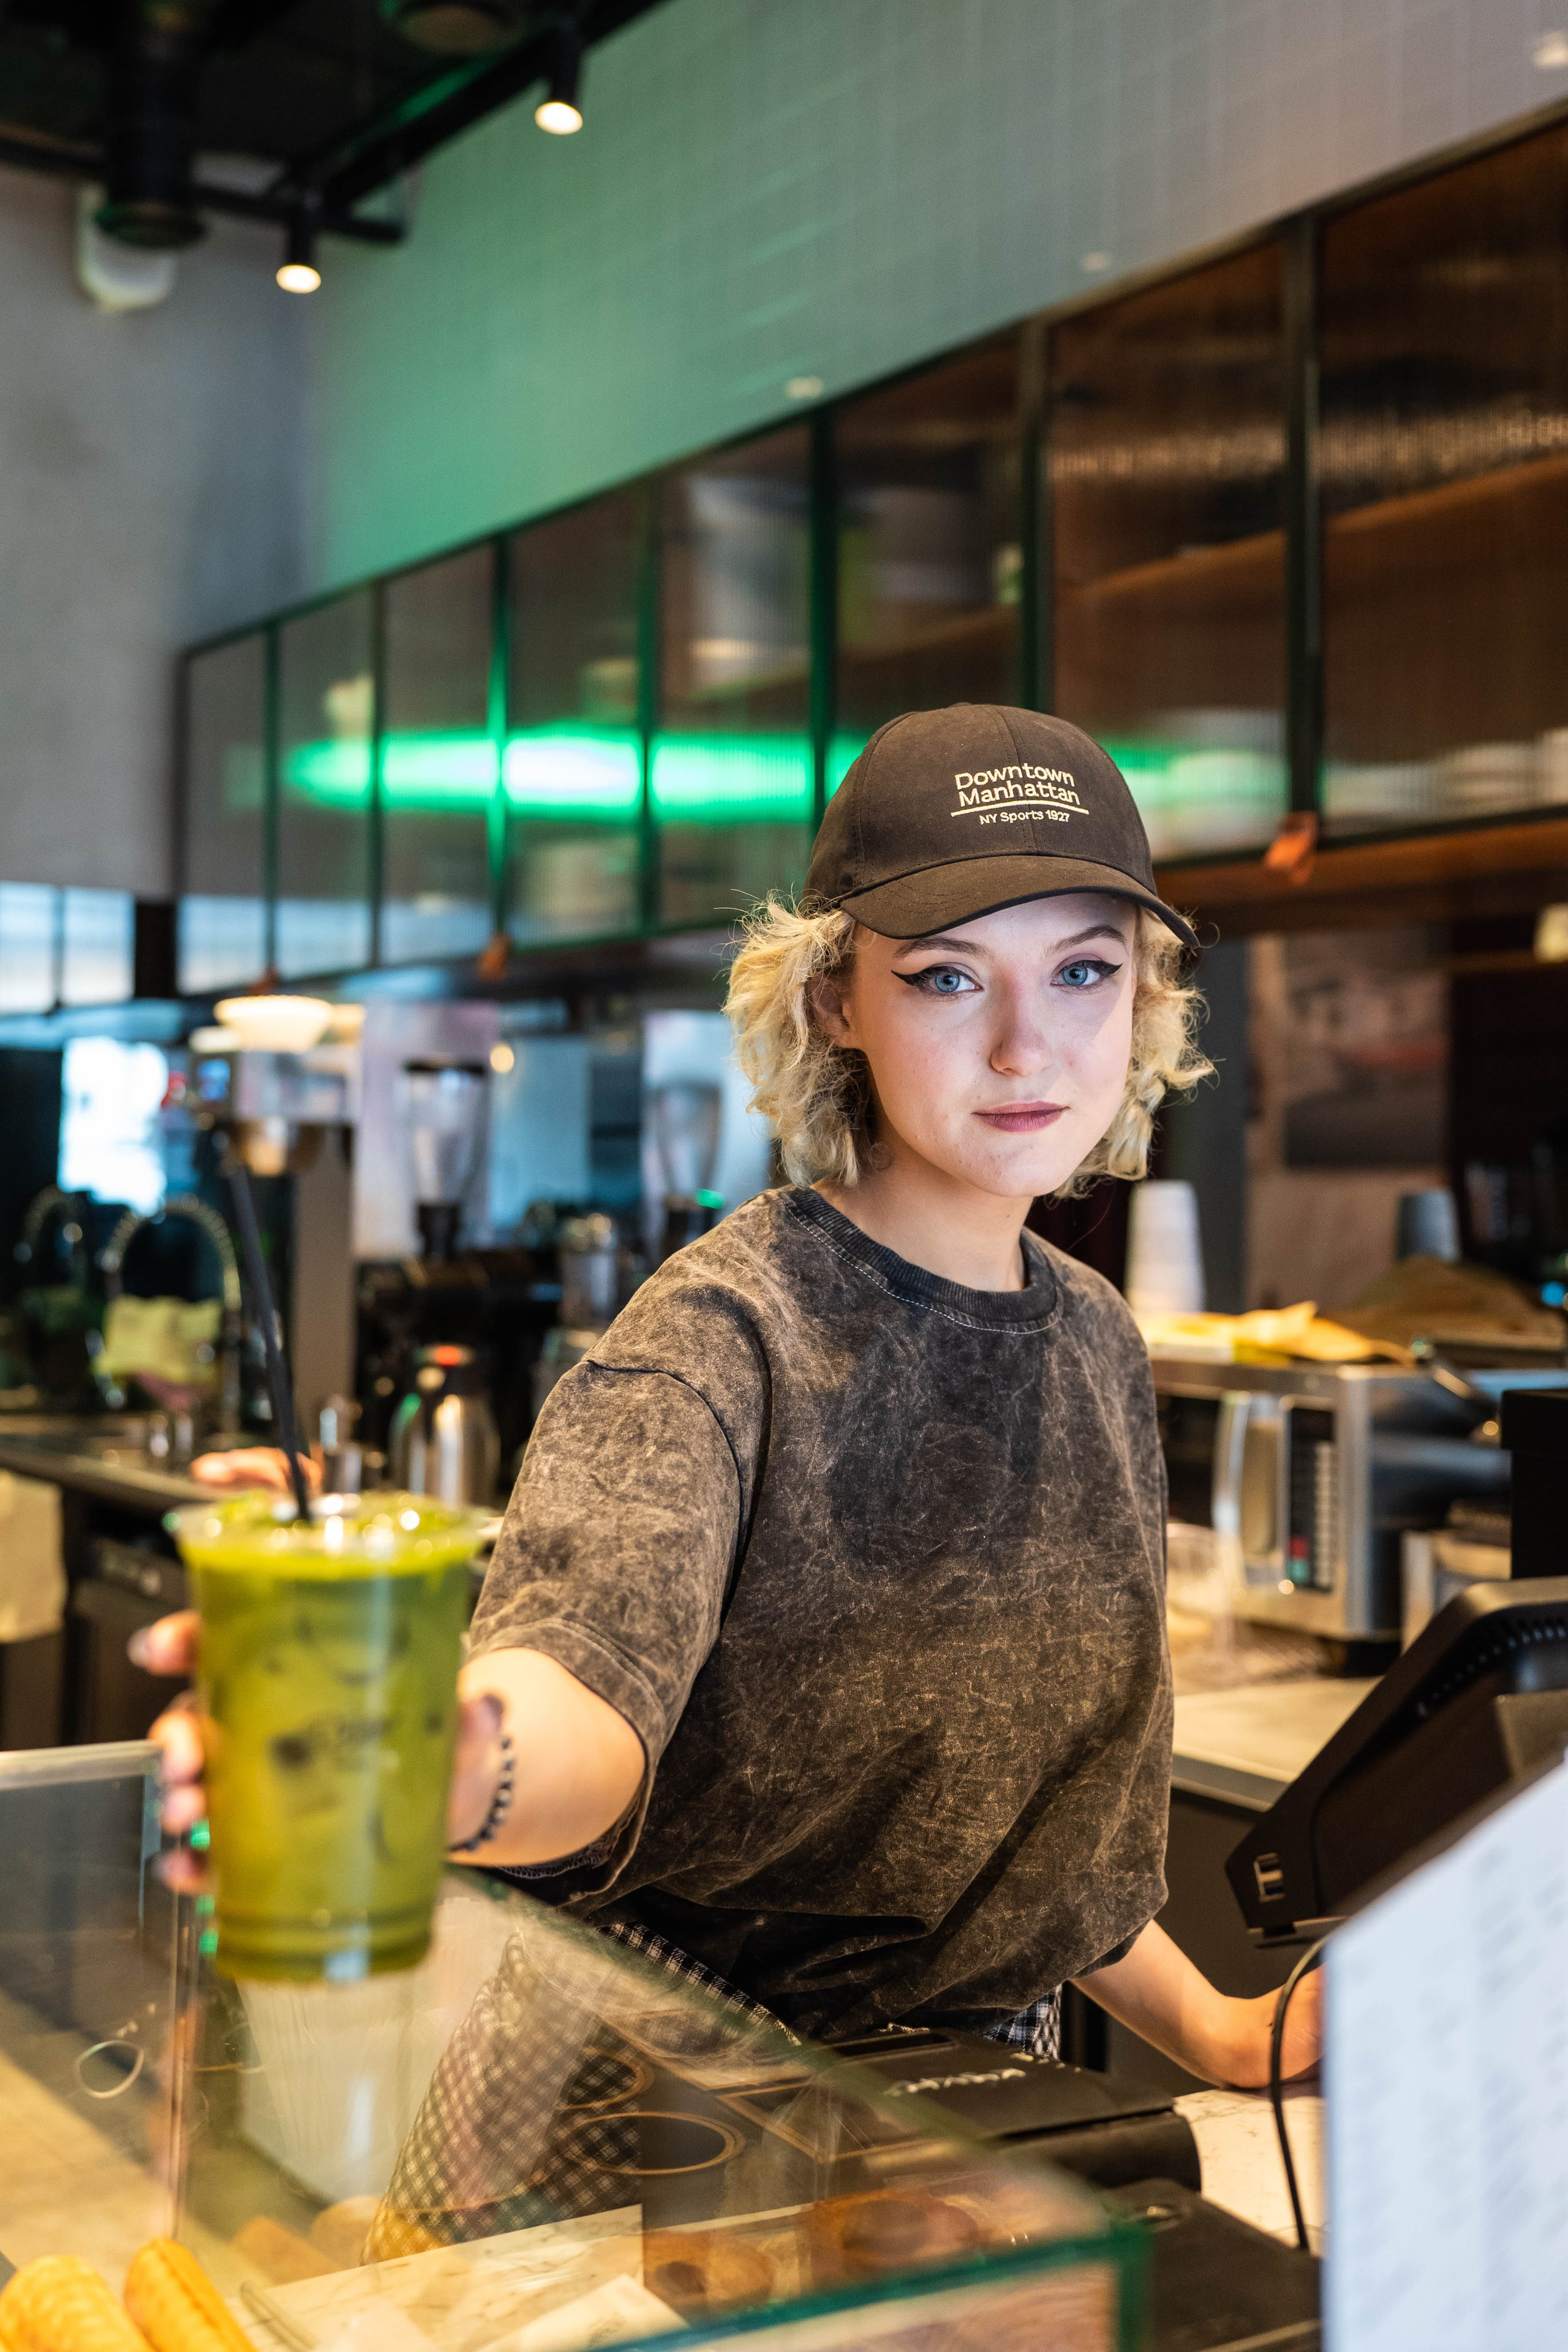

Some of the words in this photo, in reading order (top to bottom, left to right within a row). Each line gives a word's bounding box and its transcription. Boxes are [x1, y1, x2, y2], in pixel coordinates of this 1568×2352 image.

[955, 763, 1075, 790] Downtown
[958, 780, 1080, 807] Manhattan
[979, 813, 998, 824] NY
[1000, 810, 1044, 823] Sports
[1046, 809, 1070, 822] 1927
